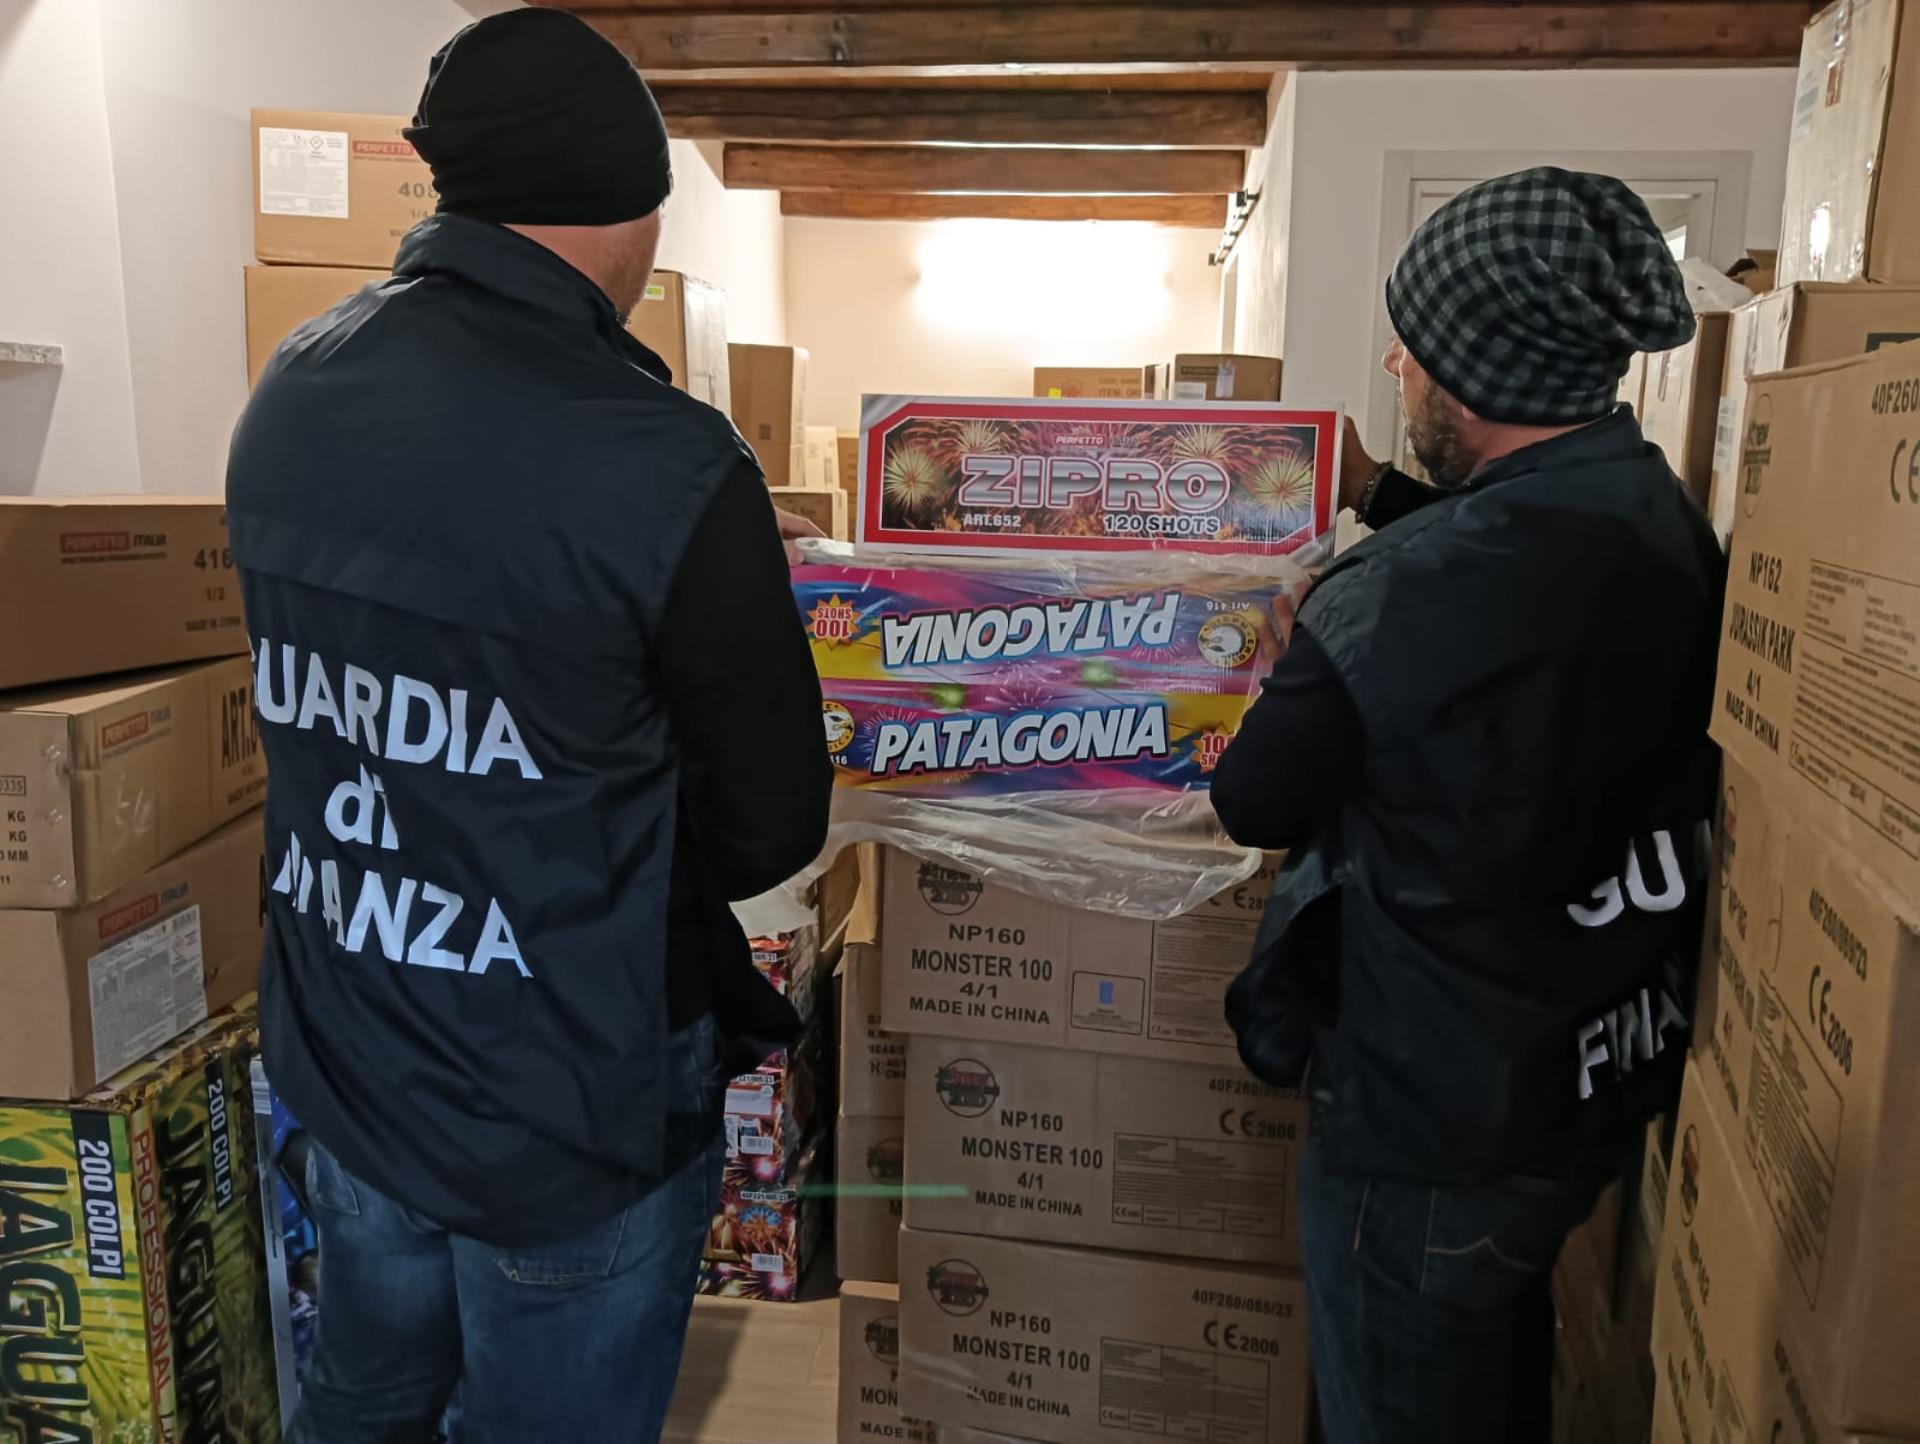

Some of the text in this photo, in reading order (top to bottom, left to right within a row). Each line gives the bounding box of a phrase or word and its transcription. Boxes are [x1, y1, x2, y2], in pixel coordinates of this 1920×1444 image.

[1055, 434, 1104, 446] PERFETTO
[958, 454, 1231, 514] ZIPRO
[963, 513, 1022, 527] ART.652
[1103, 513, 1220, 534] 120 SHOTS
[1749, 551, 1782, 594] NP162
[816, 606, 852, 620] SHOTS
[815, 619, 851, 638] 100
[883, 593, 1180, 667] PATAGONIA
[1767, 619, 1795, 674] PARK
[248, 632, 543, 780] UARDIA
[872, 704, 1167, 773] PATAGONIA
[1202, 734, 1233, 754] 10
[1200, 753, 1217, 766] SH
[7, 810, 26, 823] KG
[324, 762, 400, 851] di
[8, 830, 28, 843] KG
[7, 849, 30, 862] MM
[1566, 818, 1712, 927] GU
[271, 830, 535, 979] ANZA
[948, 923, 1026, 946] NP160
[911, 948, 1053, 982] MONSTER 100
[959, 981, 999, 999] 4/1
[909, 996, 1051, 1025] MADE IN CHINA
[1000, 1110, 1064, 1132] NP160
[1256, 1121, 1297, 1141] 2806
[208, 1078, 233, 1209] 200 COLPI
[961, 1136, 1104, 1170] MONSTER 100
[1017, 1171, 1044, 1191] 4/1
[78, 1138, 124, 1275] 200 COLPI
[975, 1190, 1083, 1217] MADE IN CHINA
[132, 1130, 172, 1400] PROFESSIONAL
[155, 1116, 226, 1444] JAGUA
[990, 1310, 1051, 1334] NP160
[1203, 1319, 1280, 1357] CE 2806
[952, 1333, 1091, 1373] MONSTER 100
[1006, 1371, 1033, 1391] 4/1
[860, 1386, 898, 1407] MON
[1009, 1391, 1024, 1409] IN
[1026, 1397, 1072, 1418] CHINA
[860, 1421, 902, 1439] MADE
